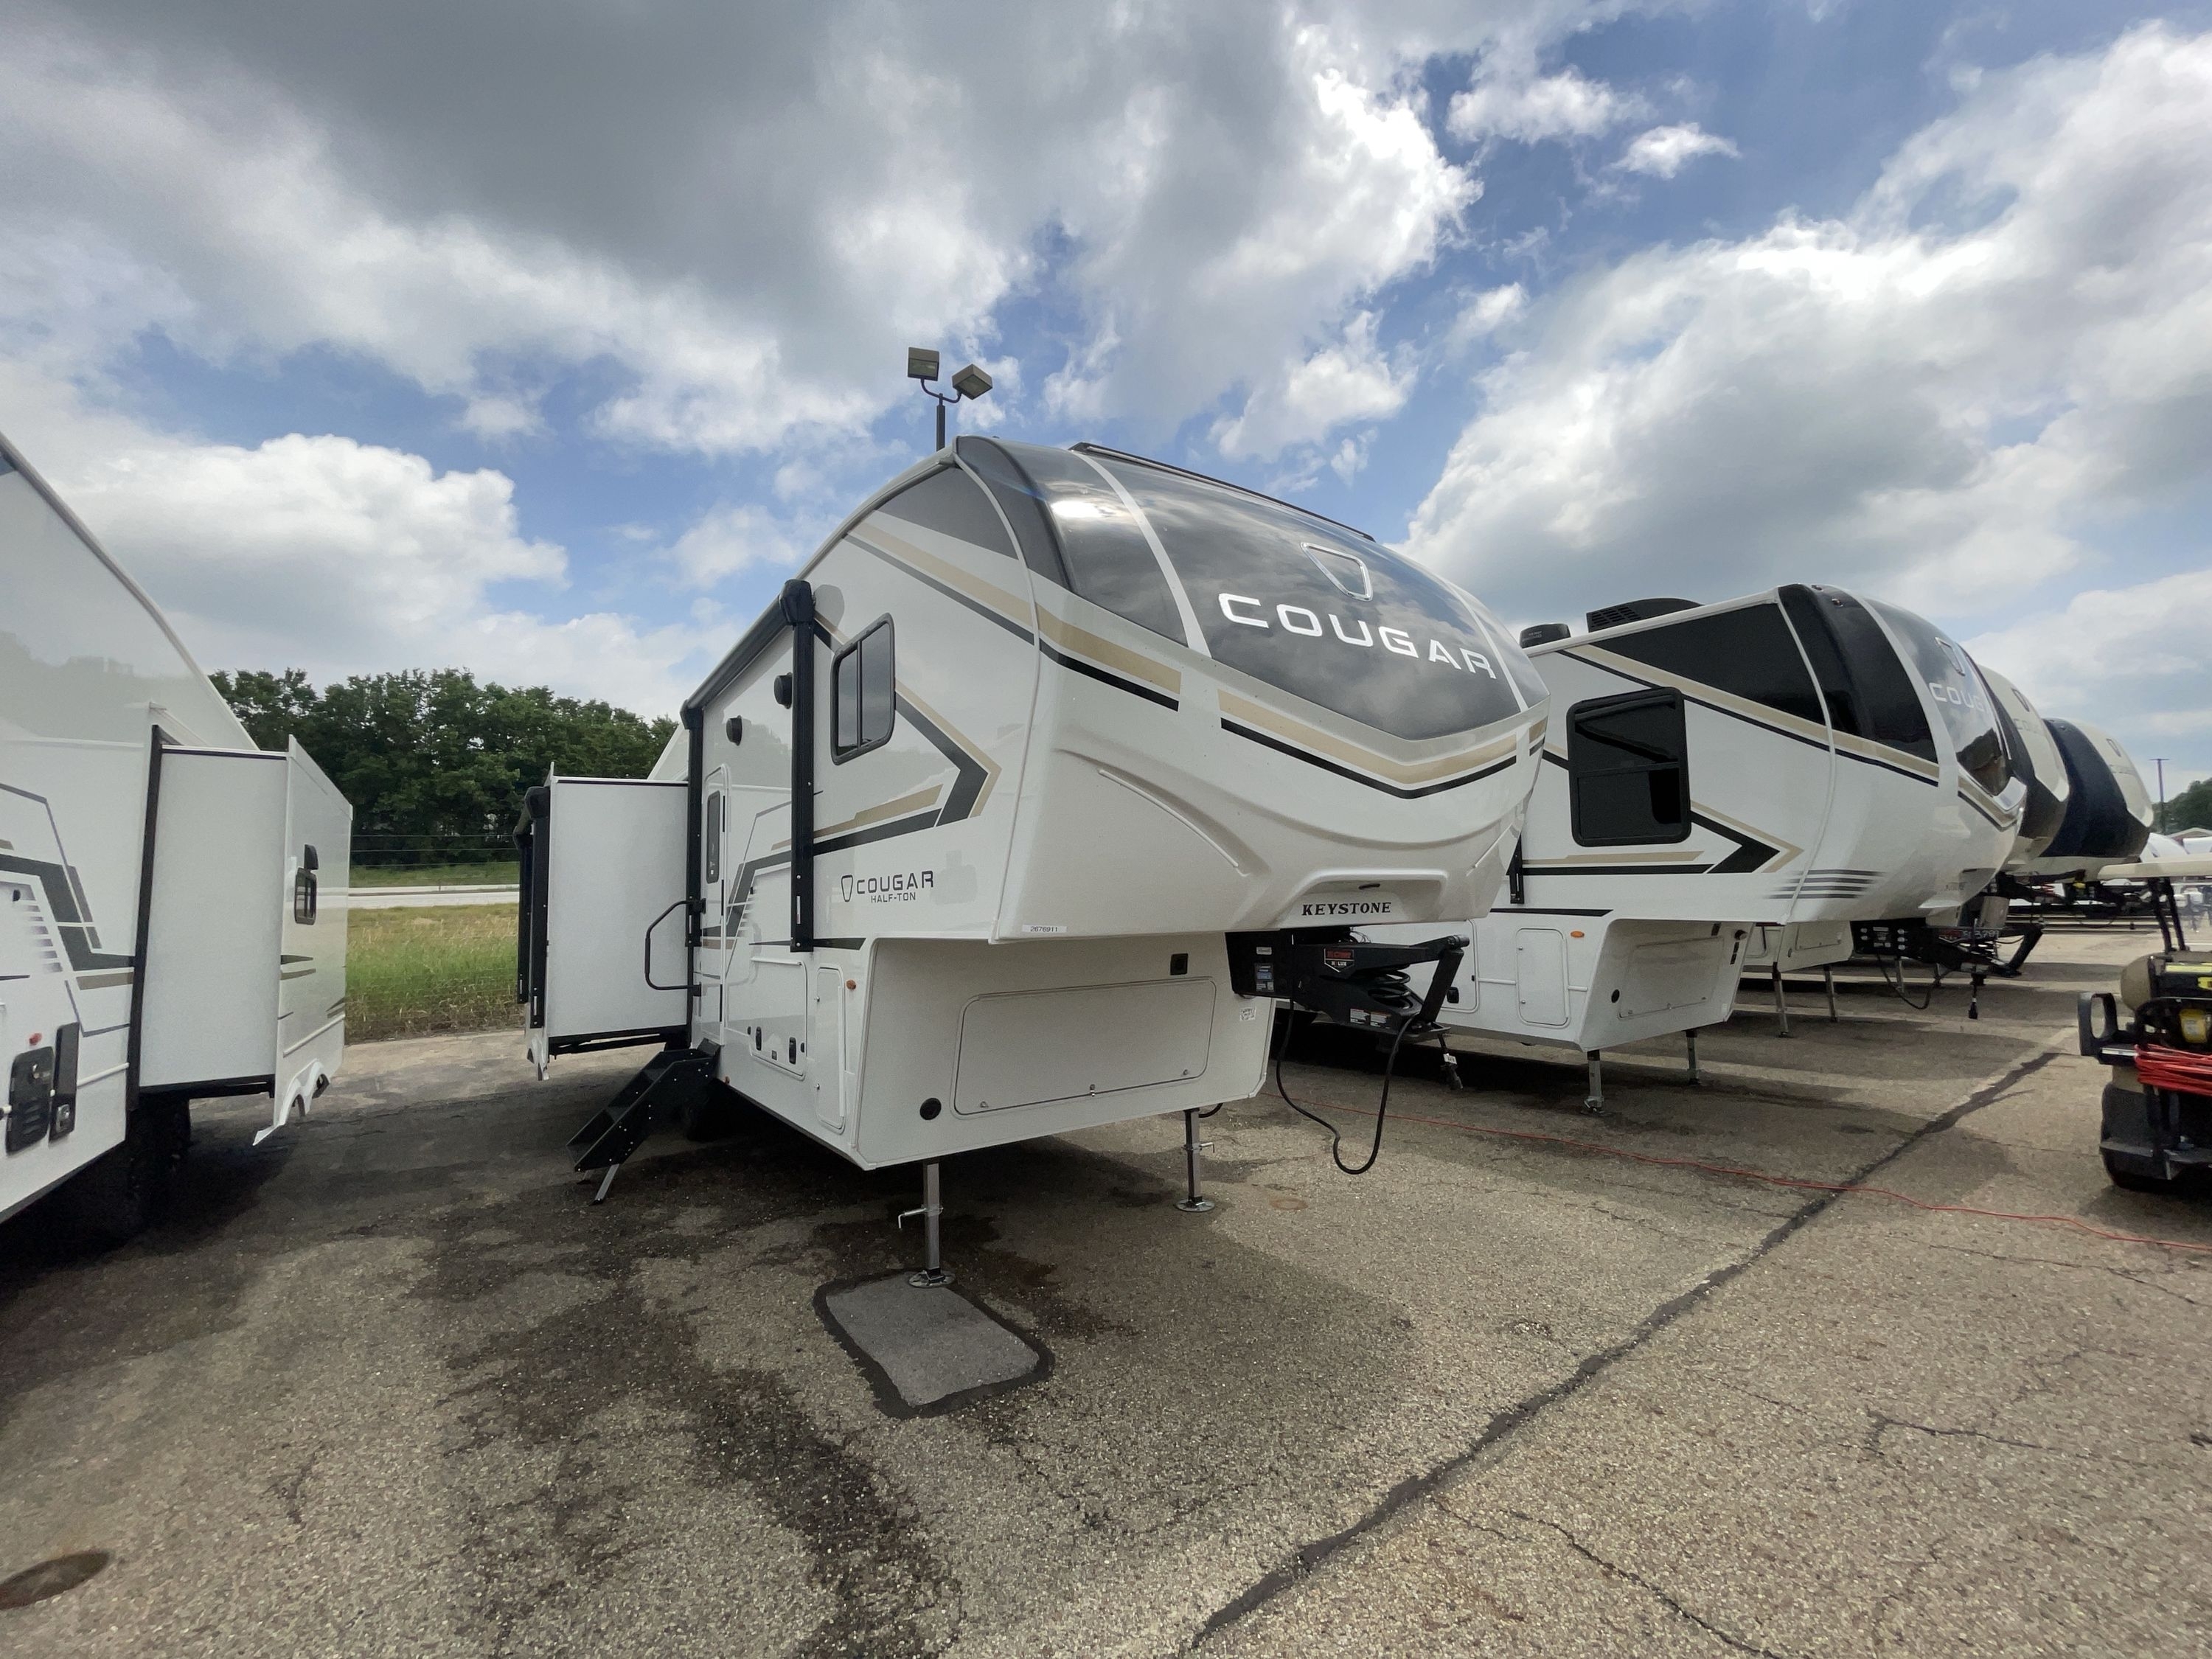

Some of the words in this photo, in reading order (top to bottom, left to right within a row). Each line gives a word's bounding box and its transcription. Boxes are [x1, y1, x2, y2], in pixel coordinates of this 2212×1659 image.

[1218, 593, 1496, 679] COUGAR
[1929, 682, 1988, 713] COUG
[857, 870, 933, 894] COUGAR
[871, 892, 916, 903] HALF-TON
[1301, 902, 1391, 916] KEYSTONE
